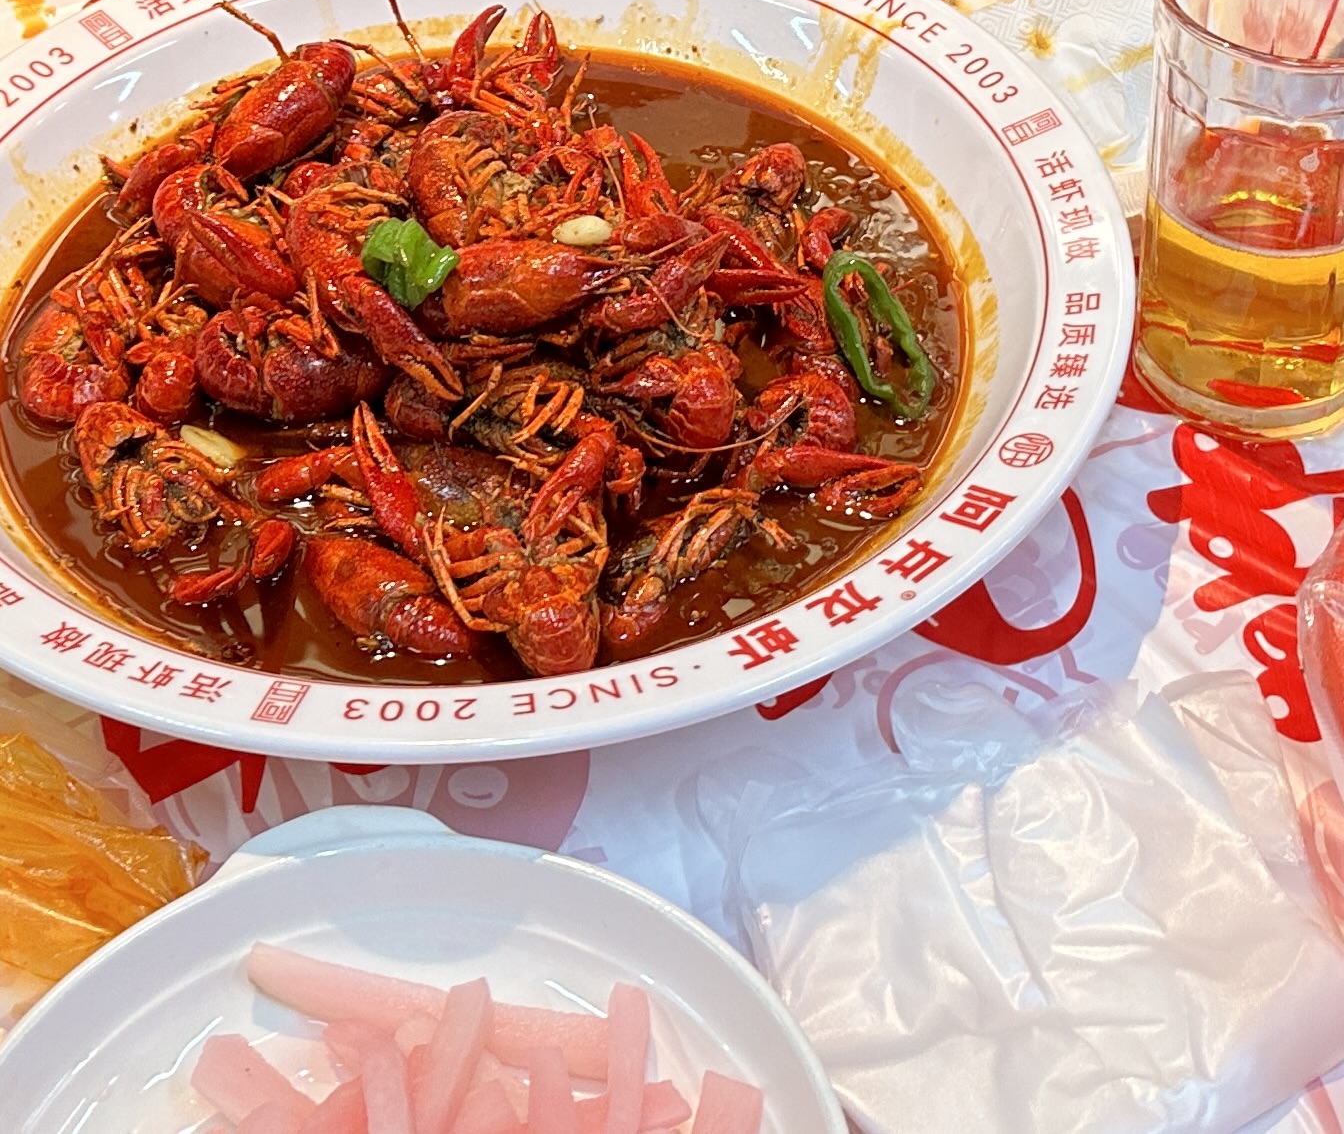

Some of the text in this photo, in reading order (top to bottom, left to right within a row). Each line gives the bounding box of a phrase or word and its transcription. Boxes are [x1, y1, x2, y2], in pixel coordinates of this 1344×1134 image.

[945, 43, 1020, 104] 2003
[1034, 149, 1102, 410] 活虾现做 品质臻选
[727, 484, 1020, 671] 阿兵龙虾
[40, 621, 233, 704] 活虾现做
[512, 664, 680, 717] SINCE
[343, 697, 478, 723] 2003
